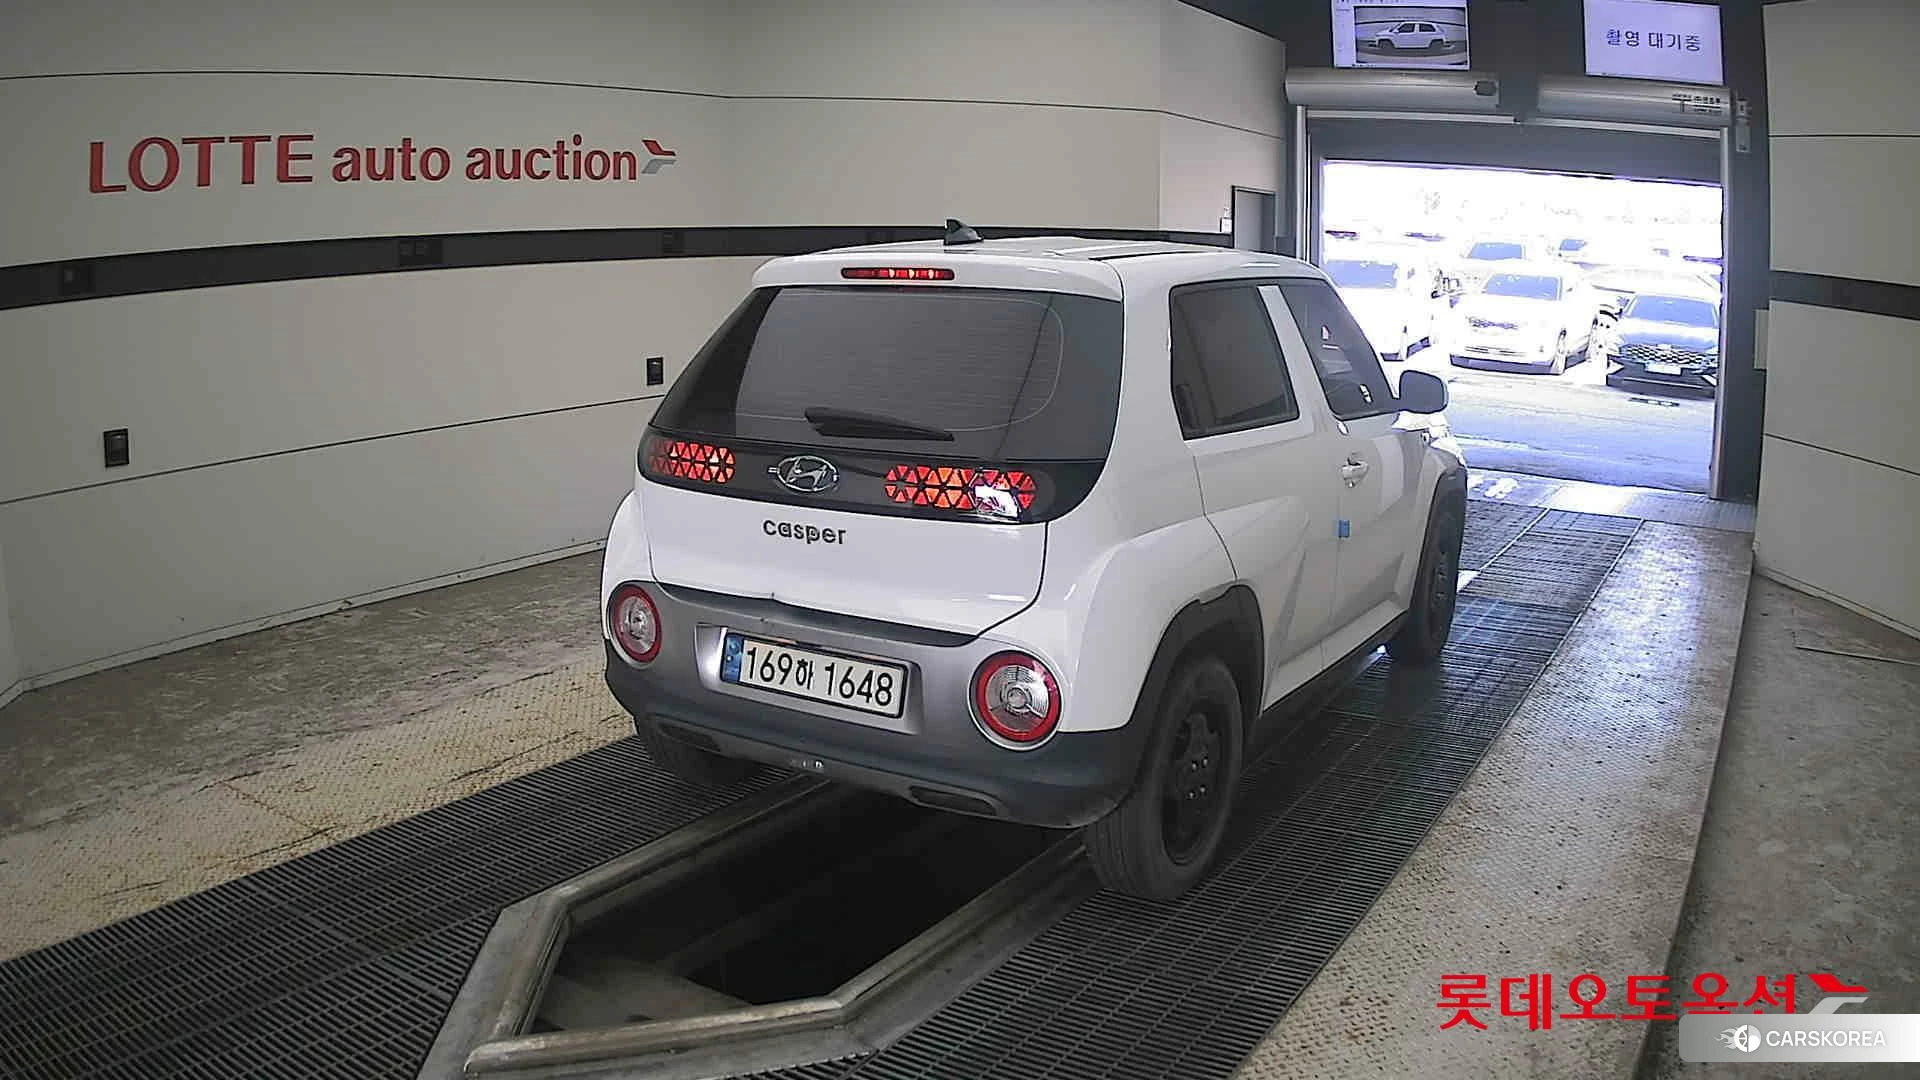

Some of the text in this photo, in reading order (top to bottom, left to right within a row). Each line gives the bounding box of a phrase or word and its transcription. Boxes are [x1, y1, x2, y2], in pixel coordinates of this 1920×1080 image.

[1648, 32, 1701, 52] 대기중
[89, 134, 637, 193] LOTTE auto auction
[763, 519, 847, 545] casper
[746, 646, 894, 706] 169하 1648
